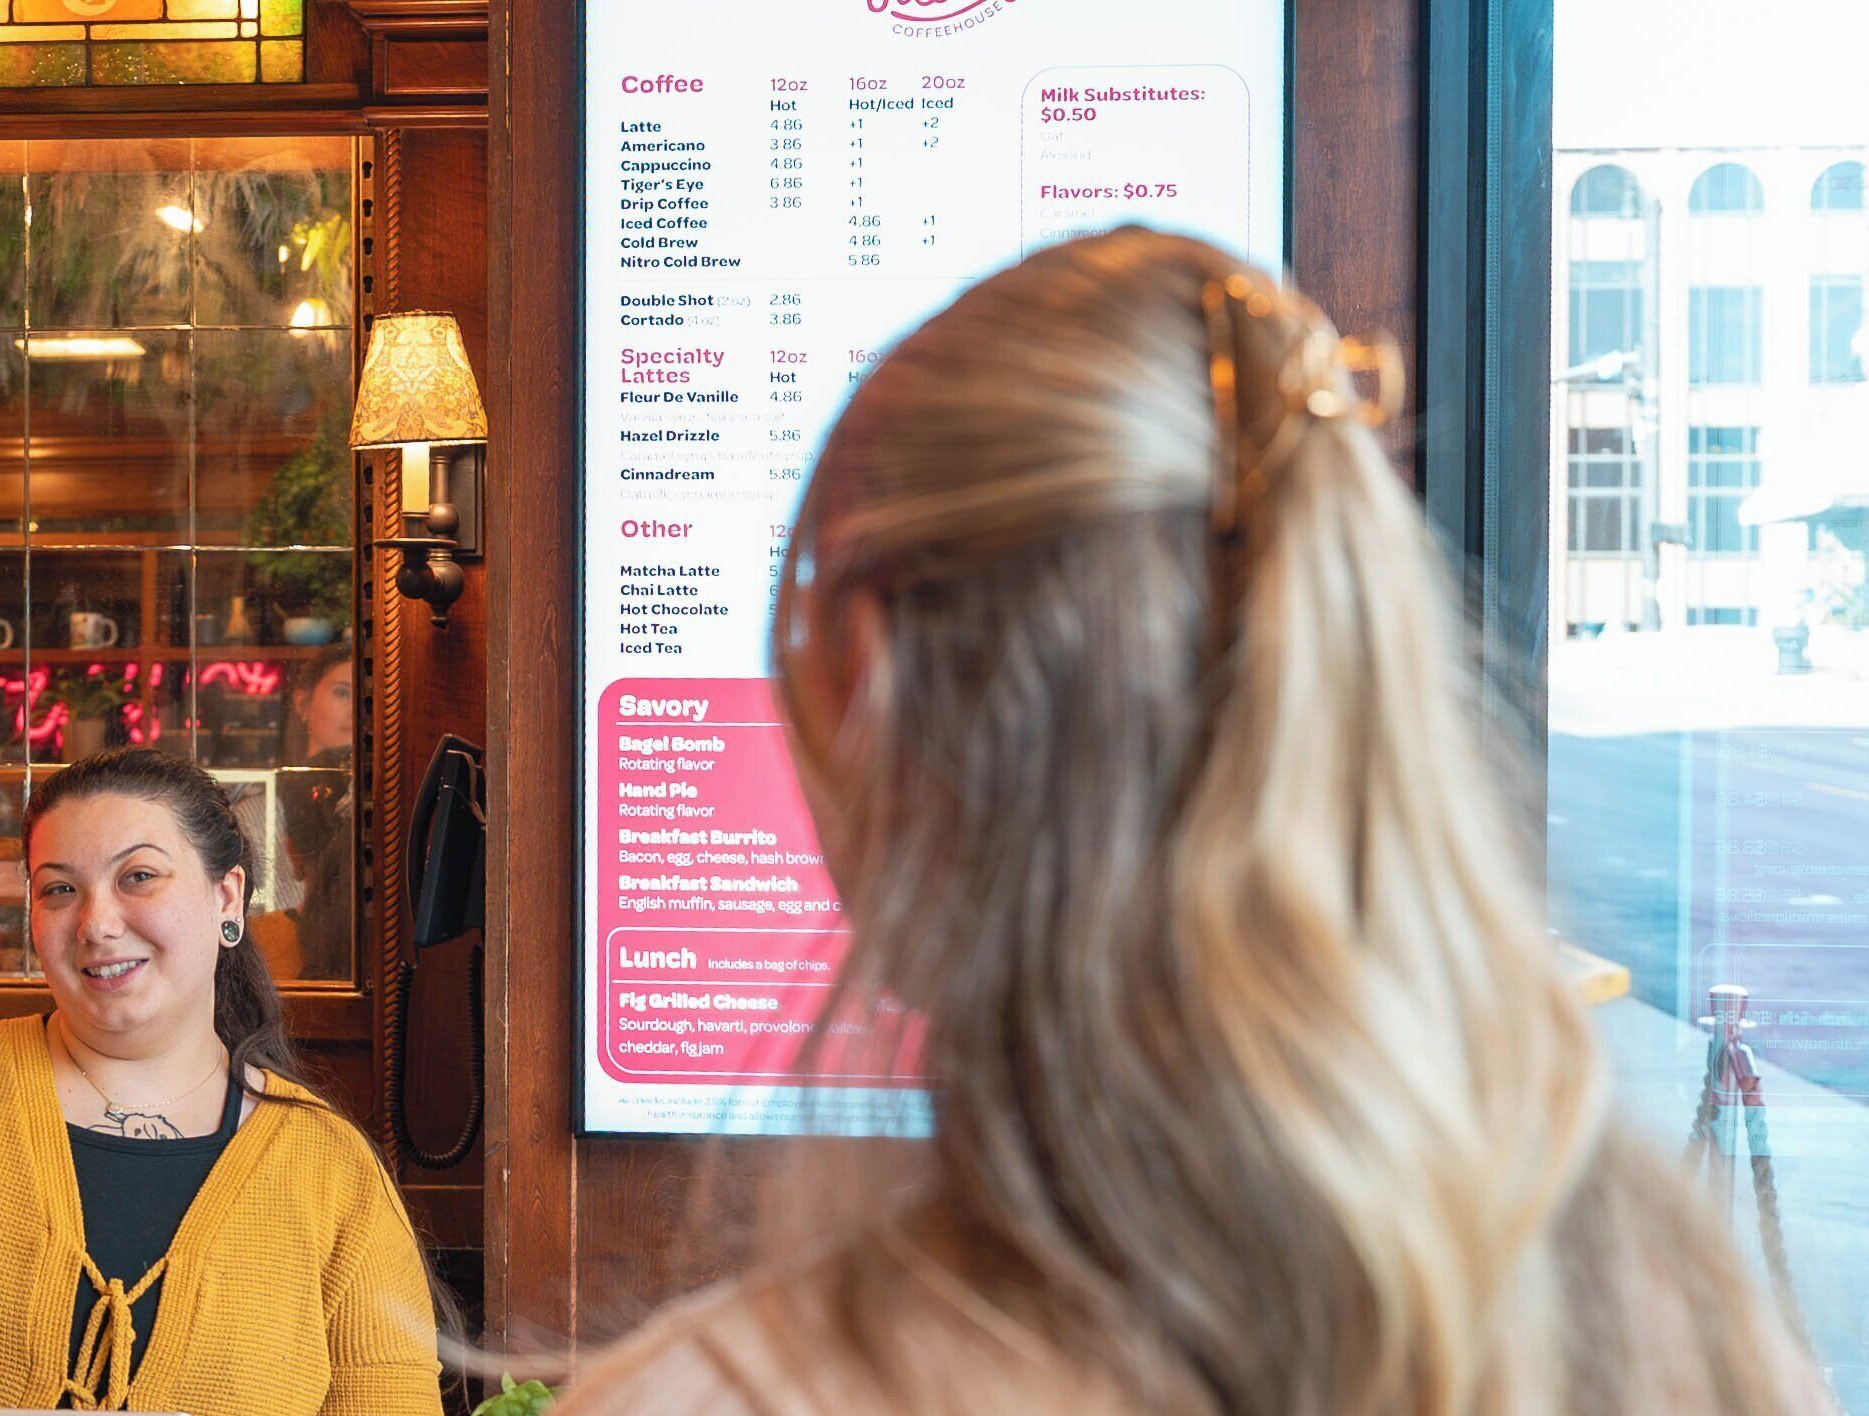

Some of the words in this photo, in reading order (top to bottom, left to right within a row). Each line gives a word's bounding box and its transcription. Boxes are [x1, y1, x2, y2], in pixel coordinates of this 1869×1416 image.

[892, 0, 1003, 38] COFFEEHOUSE
[622, 75, 703, 93] Coffee
[771, 79, 807, 91] 12oz
[850, 77, 887, 90] 16oz
[922, 76, 965, 88] 20oz
[1042, 88, 1078, 102] Milk
[1084, 86, 1204, 101] Substitutes:
[771, 100, 796, 111] Hot
[850, 98, 914, 112] Hot/Iced
[922, 97, 953, 108] Iced
[1042, 107, 1096, 123] $0.50
[621, 122, 661, 132] Latte
[850, 119, 863, 129] +1
[923, 118, 939, 128] +2
[621, 140, 705, 151] Americano
[850, 138, 863, 148] +1
[621, 158, 711, 174] Cappuccino
[850, 158, 863, 168] +1
[621, 179, 672, 193] Tiger's
[677, 179, 703, 192] Eye
[850, 178, 863, 188] +1
[1041, 185, 1118, 198] Flavors:
[1124, 183, 1177, 199] $0.75
[621, 198, 653, 212] Drip
[658, 198, 708, 209] Coffee
[850, 197, 863, 207] +1
[621, 217, 652, 229] Iced
[657, 217, 707, 228] Coffee
[849, 216, 880, 226] 4.86
[923, 216, 935, 226] +1
[621, 237, 654, 248] Cold
[659, 238, 698, 248] Brew
[923, 236, 935, 246] +1
[621, 256, 659, 267] Nitro
[664, 256, 697, 267] Cold
[702, 257, 740, 267] Brew
[621, 295, 675, 306] Double
[679, 294, 713, 305] Shot
[770, 294, 800, 305] 2.86
[621, 314, 683, 325] Cortado
[770, 314, 801, 324] 3.86
[622, 348, 724, 369] Specialty
[770, 350, 807, 363] 12oz
[622, 366, 690, 383] Lattes
[771, 372, 796, 382] Hot
[621, 391, 660, 403] Fleur
[664, 392, 683, 402] De
[687, 391, 738, 402] Vanille
[770, 392, 801, 402] 4.86
[621, 430, 662, 441] Hazel
[666, 430, 719, 441] Drizzle
[770, 430, 800, 441] 5.86
[621, 468, 714, 480] Cinnadream
[770, 469, 800, 480] 5.86
[621, 520, 693, 537] Other
[770, 525, 794, 538] 12
[770, 546, 787, 557] Ho
[621, 565, 675, 576] Matcha
[680, 566, 719, 576] Latte
[621, 584, 653, 595] Chai
[658, 585, 698, 595] Latte
[621, 604, 647, 615] Hot
[652, 604, 728, 615] Chocolate
[621, 624, 647, 634] Hot
[651, 624, 677, 634] Tea
[621, 642, 651, 653] Iced
[656, 643, 682, 653] Tea
[619, 694, 709, 722] Savory
[619, 736, 669, 756] Bagel
[671, 736, 725, 752] Bomb
[619, 757, 675, 773] Rotating
[677, 757, 715, 771] flavor
[619, 782, 666, 798] Hand
[669, 782, 697, 798] Pie
[619, 804, 675, 819] Rotating
[677, 804, 715, 817] flavor
[619, 829, 707, 845] Breakfast
[710, 829, 777, 845] Burrito
[619, 850, 664, 866] Bacon,
[667, 852, 693, 867] egg,
[697, 850, 748, 866] cheese,
[750, 850, 783, 865] hash
[619, 875, 707, 892] Breakfast
[710, 875, 798, 892] Sandwich
[619, 896, 666, 912] English
[668, 897, 716, 911] muffin,
[718, 900, 775, 913] sausage,
[778, 900, 802, 914] egg
[804, 899, 830, 911] and
[619, 947, 696, 969] Lunch
[708, 959, 754, 970] Includes
[756, 962, 762, 970] a
[765, 959, 784, 972] bag
[786, 959, 798, 970] of
[798, 959, 830, 973] chips.
[619, 993, 646, 1011] Fig
[649, 994, 710, 1010] Grilled
[713, 994, 778, 1010] Cheese
[619, 1018, 695, 1035] Sourdough,
[697, 1019, 747, 1034] havarti,
[619, 1041, 679, 1056] cheddar,
[681, 1041, 697, 1055] fig
[697, 1041, 724, 1056] jam
